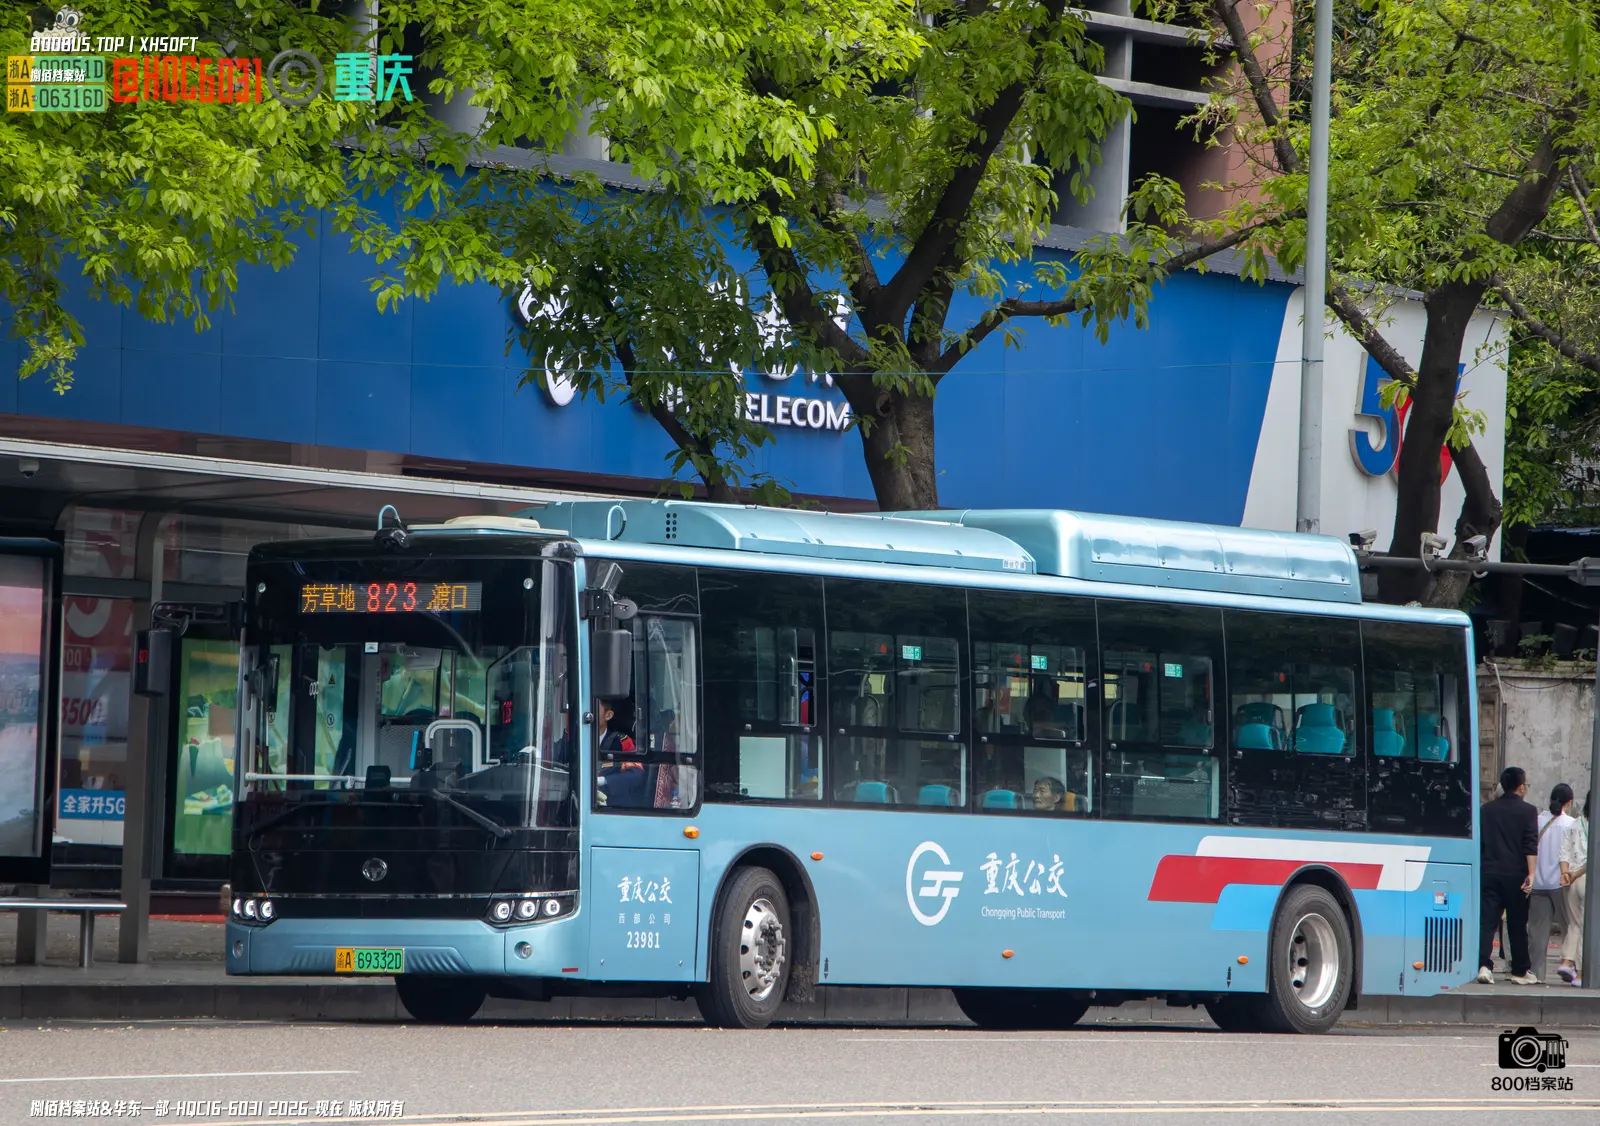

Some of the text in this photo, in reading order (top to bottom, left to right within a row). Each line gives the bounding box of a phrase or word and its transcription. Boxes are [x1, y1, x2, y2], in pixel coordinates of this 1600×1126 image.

[302, 583, 355, 613] 芳草地
[367, 582, 417, 612] 823
[63, 795, 125, 815] 全家升5G
[980, 852, 1067, 898] 重庆公交
[617, 876, 672, 904] 重庆公交
[618, 913, 671, 925] 西部公司
[981, 906, 1066, 921] Chongqing Public Transport
[626, 931, 660, 949] 23981
